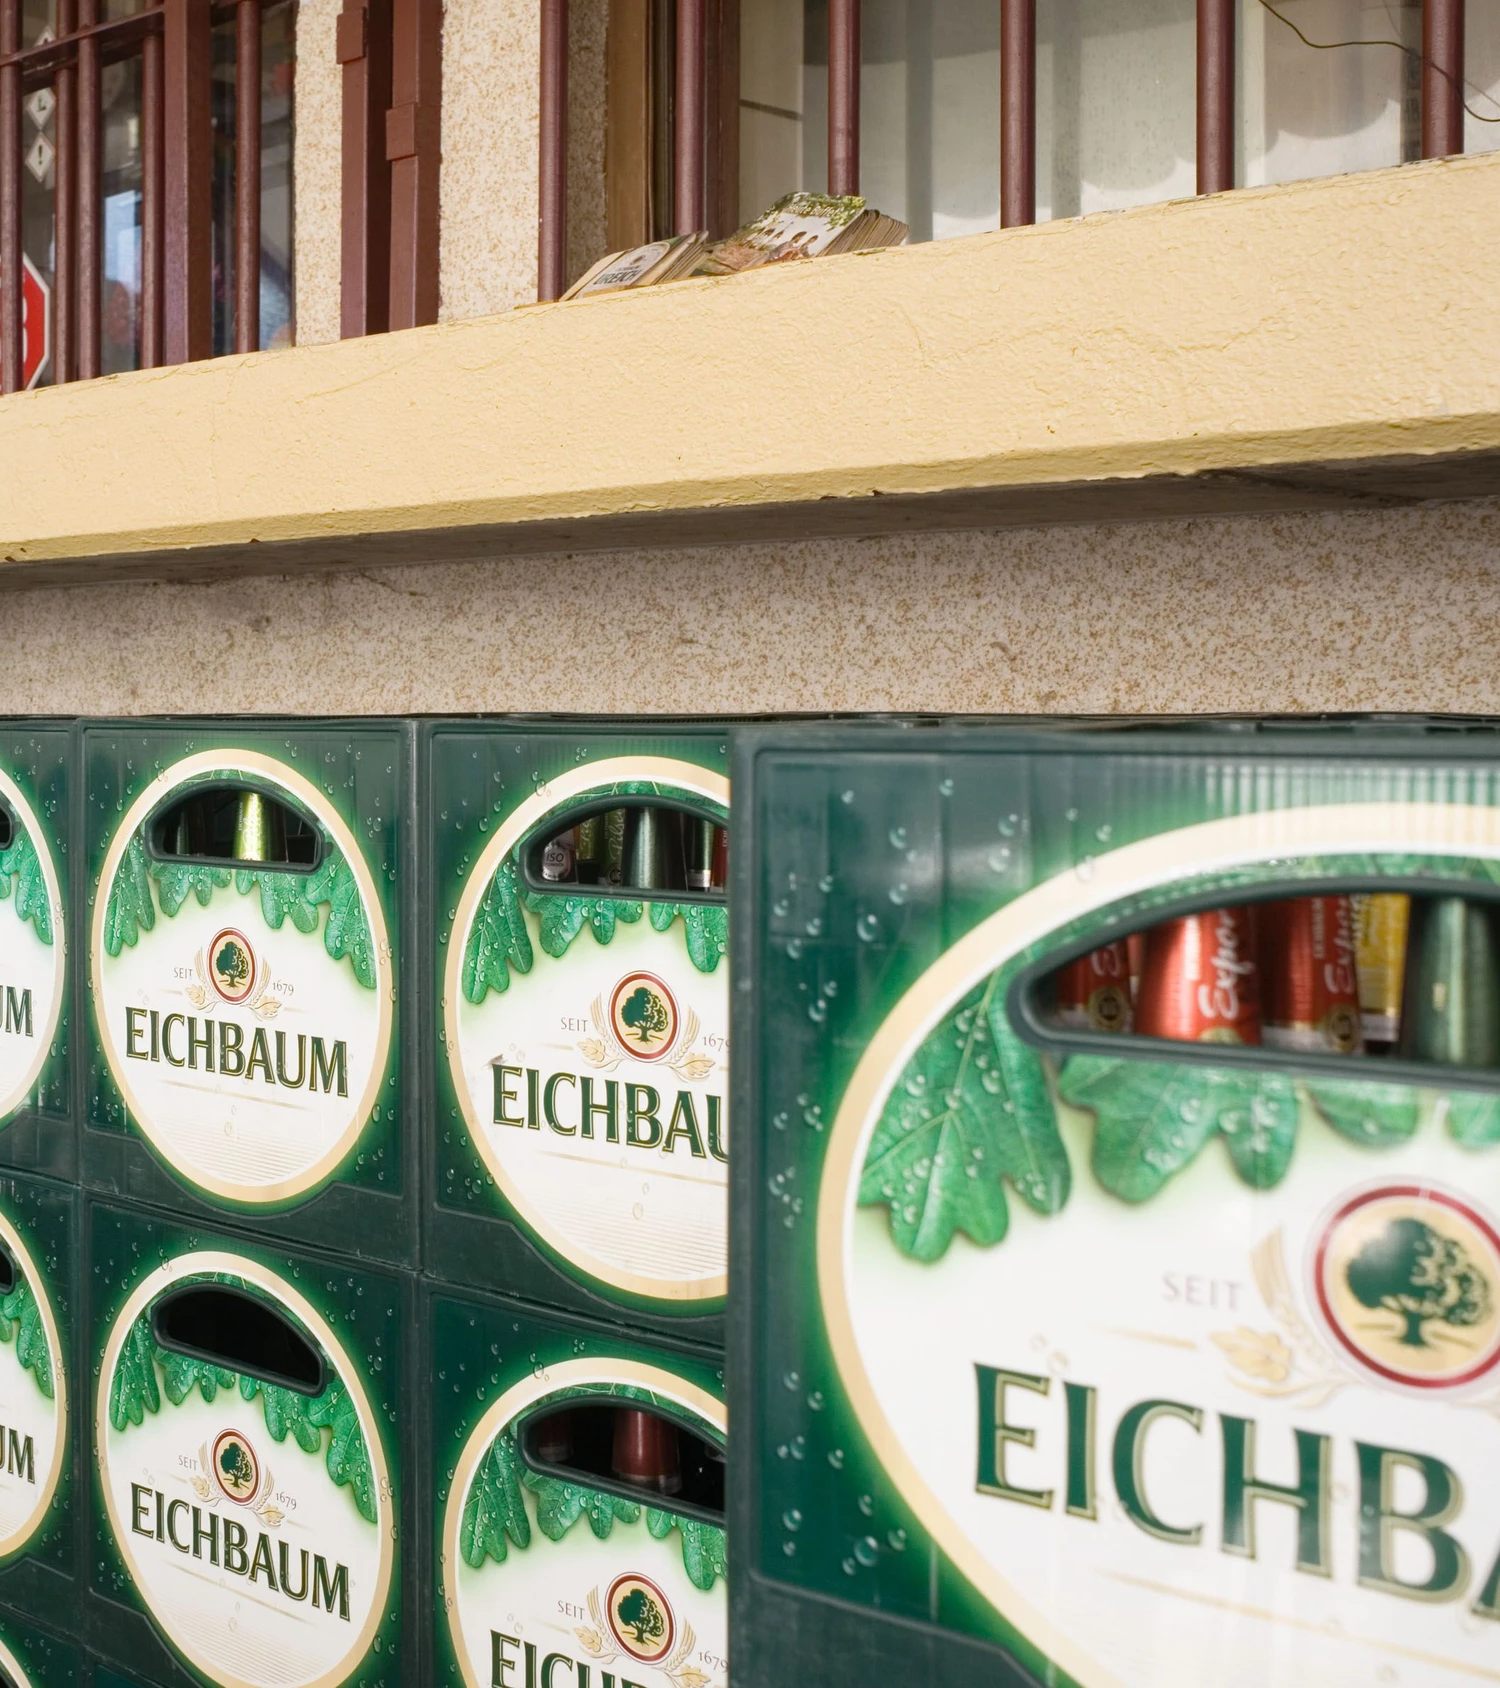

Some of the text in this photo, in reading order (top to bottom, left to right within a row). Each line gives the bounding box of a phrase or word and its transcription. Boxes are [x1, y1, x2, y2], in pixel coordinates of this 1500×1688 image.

[546, 852, 564, 862] ISO
[173, 966, 295, 997] SEIT 1679
[1198, 908, 1255, 1020] Expor
[560, 1016, 588, 1033] SEIT
[125, 1005, 349, 1098] EICHBAUM
[1162, 1271, 1242, 1311] SEIT
[178, 1454, 298, 1511] SEIT 1679
[973, 1362, 1500, 1622] EICHB
[130, 1481, 351, 1622] EICHBAUM
[557, 1599, 586, 1621] SEIT
